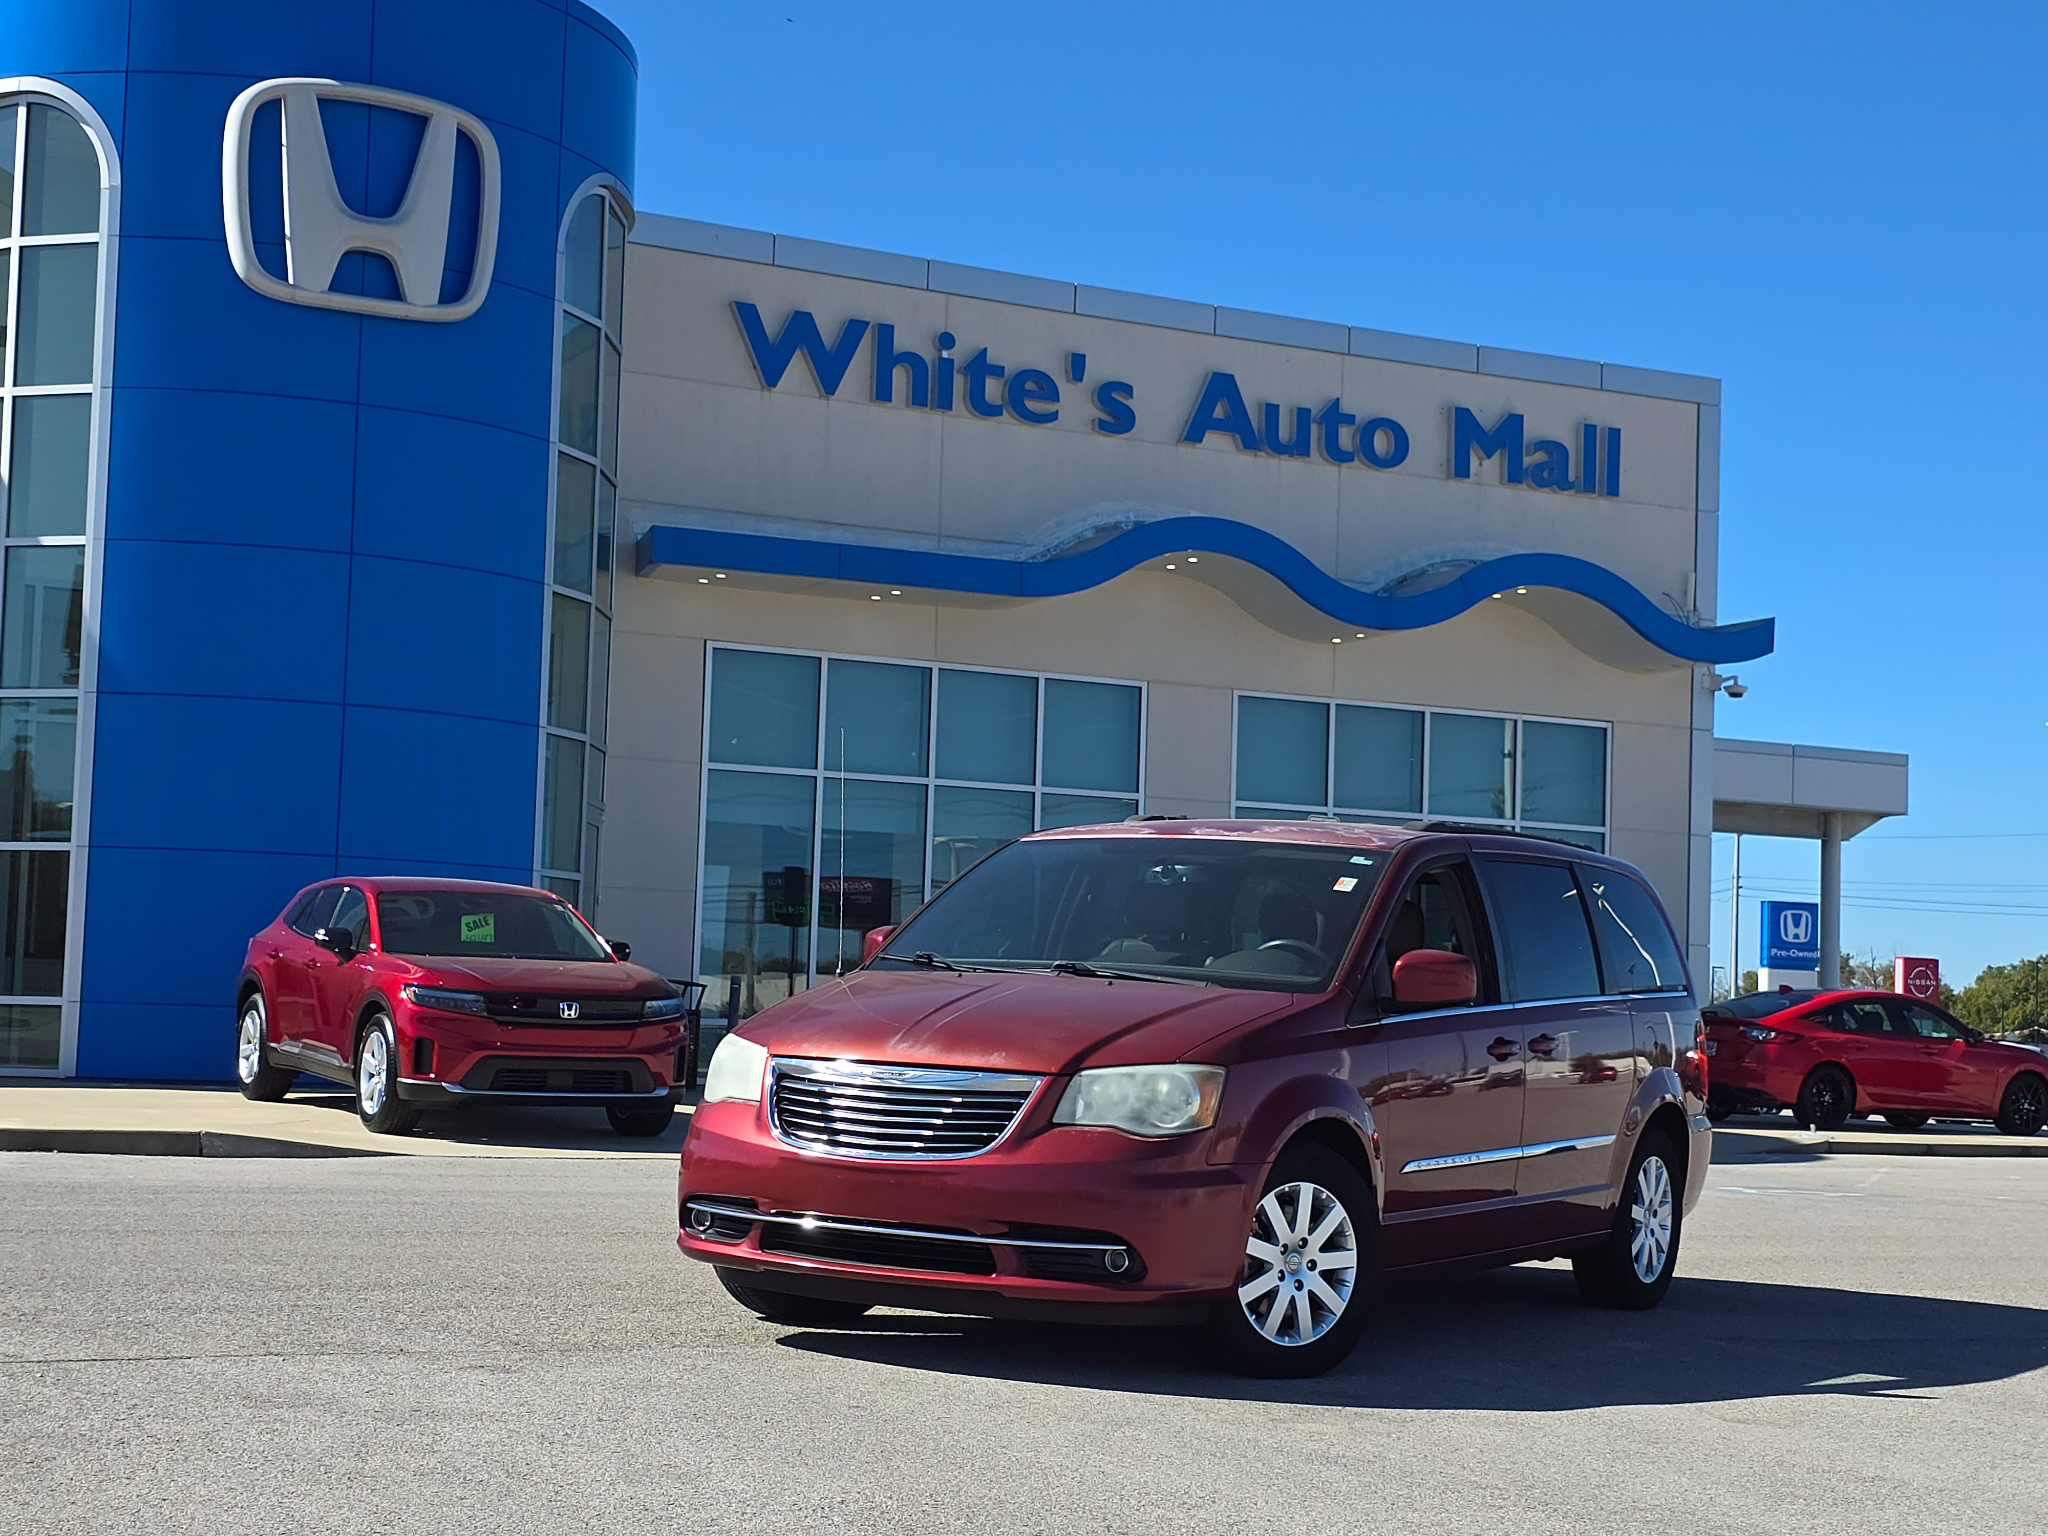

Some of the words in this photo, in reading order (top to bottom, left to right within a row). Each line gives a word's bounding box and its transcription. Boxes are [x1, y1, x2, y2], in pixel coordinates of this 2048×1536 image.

[732, 301, 1137, 435] White's
[1178, 371, 1410, 470] Auto
[1449, 406, 1622, 497] Mall
[464, 916, 491, 932] SALE
[1770, 948, 1818, 958] Pre-Owned
[1416, 1155, 1481, 1169] CHRYSLER
